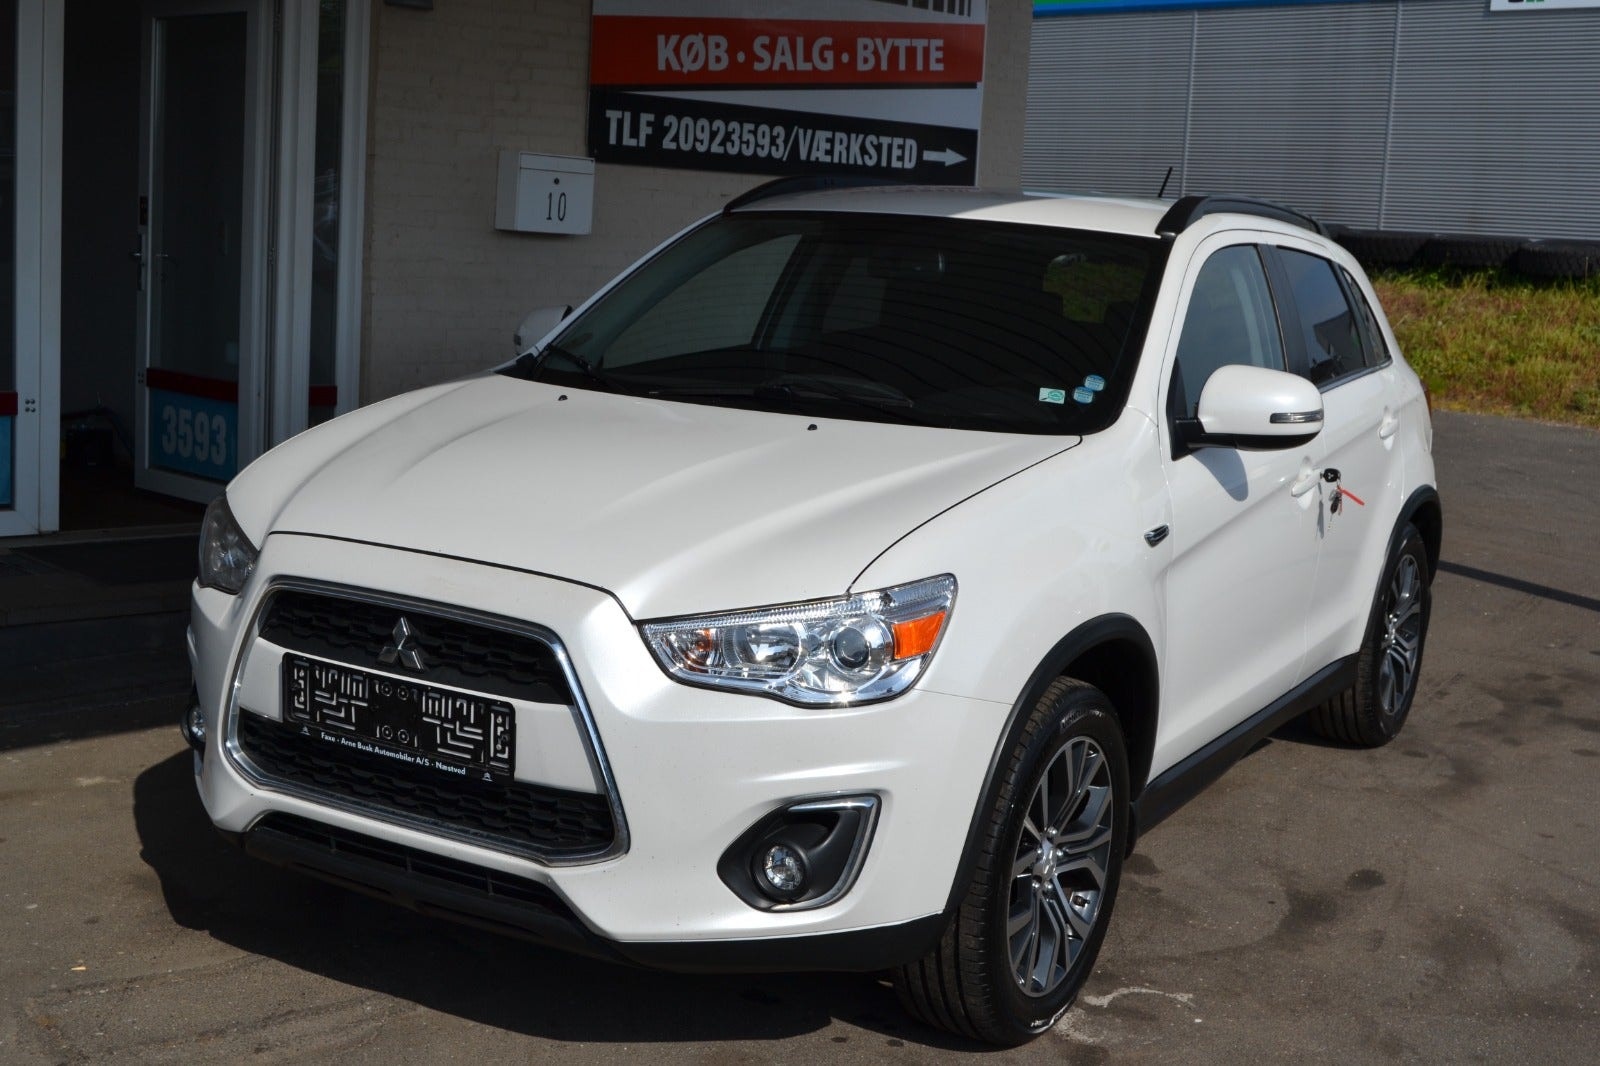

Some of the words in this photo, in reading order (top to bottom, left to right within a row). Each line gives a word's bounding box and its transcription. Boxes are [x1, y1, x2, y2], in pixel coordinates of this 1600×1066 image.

[657, 32, 729, 74] KØB
[753, 35, 834, 72] SALG
[856, 38, 944, 72] BYTTE
[605, 110, 655, 147] TLF
[546, 192, 567, 221] 10
[162, 405, 227, 466] 3593
[321, 732, 336, 742] Faxe
[341, 737, 357, 748] Arne
[357, 742, 373, 753] Busk
[416, 754, 430, 767] A/S
